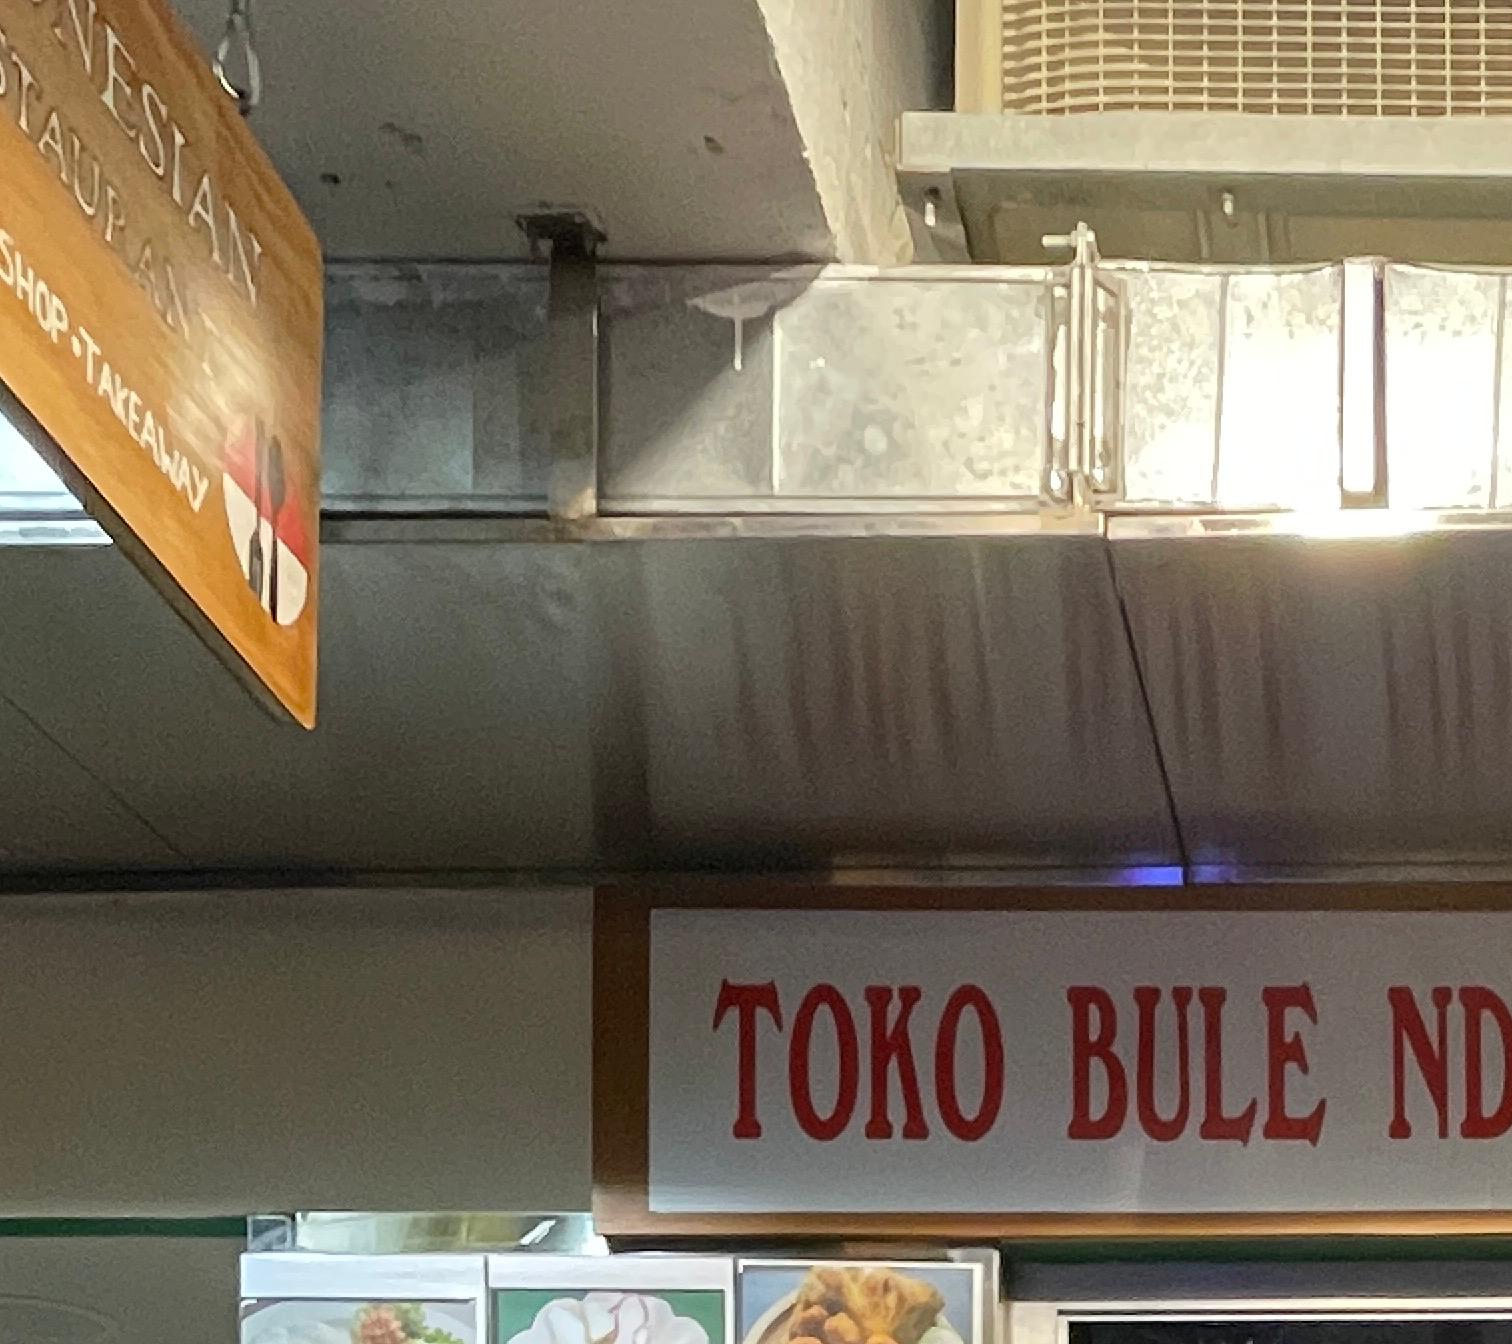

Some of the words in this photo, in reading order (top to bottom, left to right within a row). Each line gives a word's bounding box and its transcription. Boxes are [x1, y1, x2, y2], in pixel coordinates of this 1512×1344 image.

[32, 0, 262, 306] NESIAN
[0, 228, 69, 344] SHOP
[78, 326, 210, 513] TAKEAWAY
[712, 978, 1004, 1143] TOKO
[1067, 980, 1327, 1149] BULE
